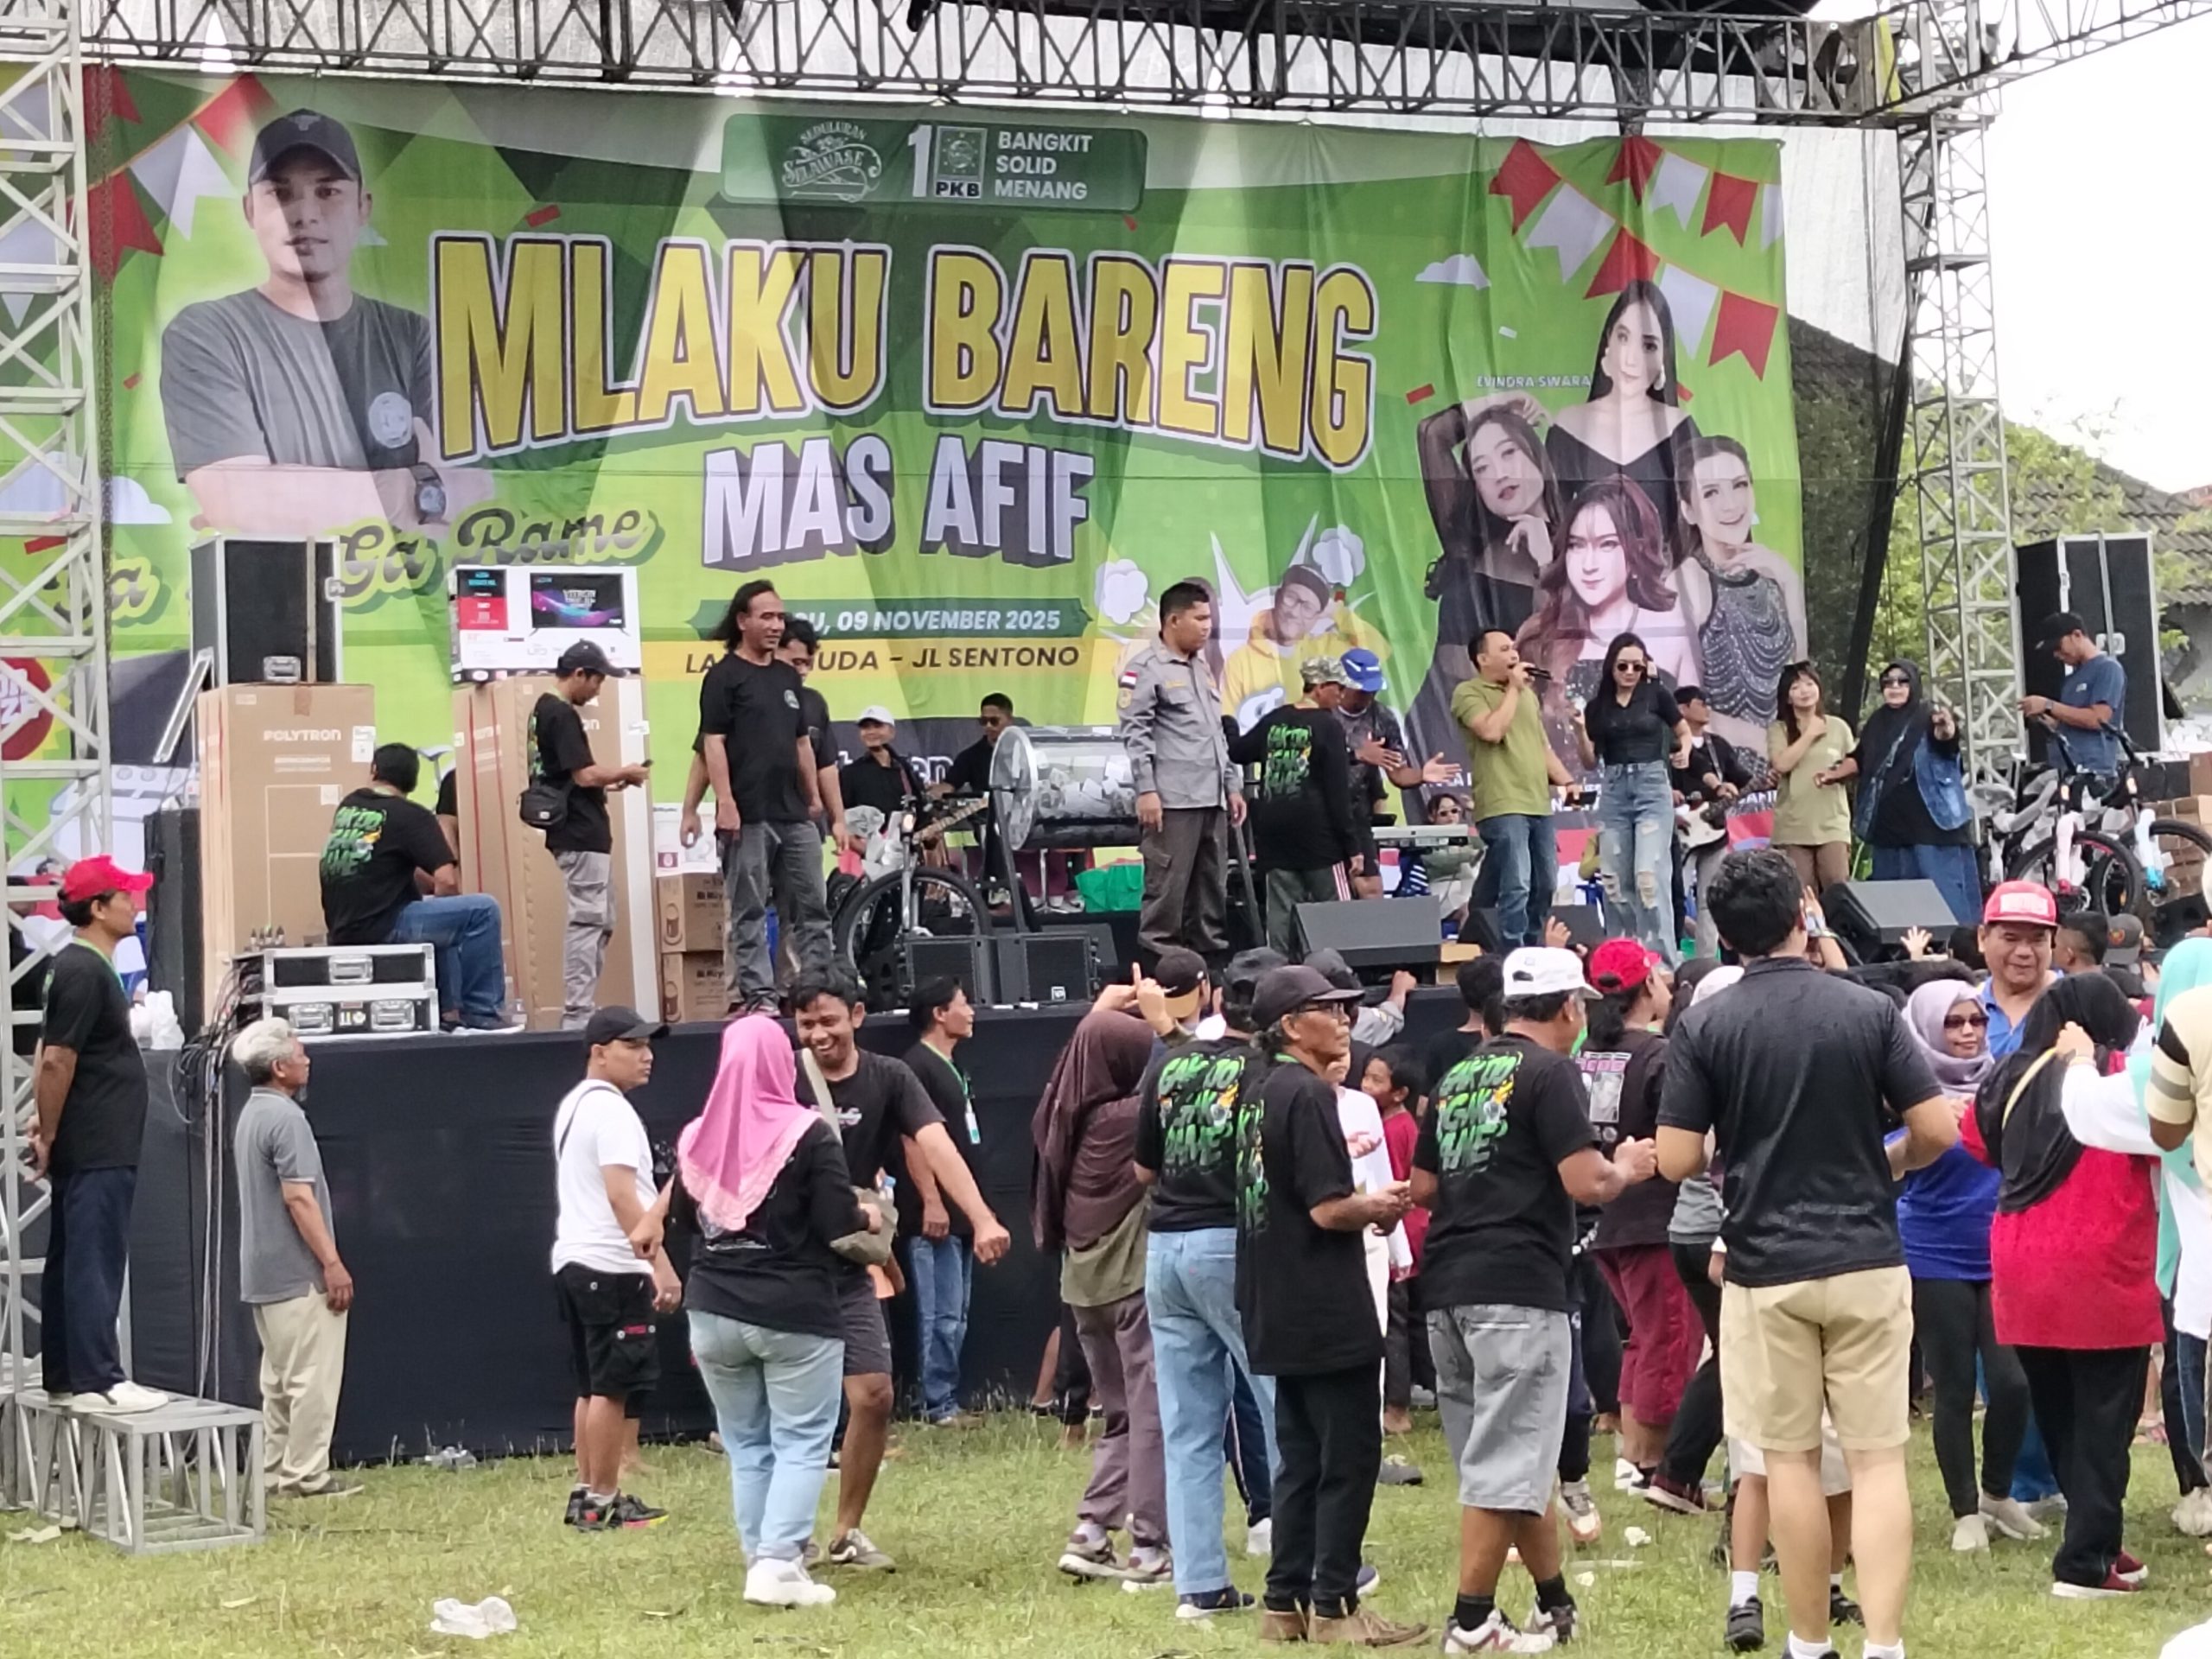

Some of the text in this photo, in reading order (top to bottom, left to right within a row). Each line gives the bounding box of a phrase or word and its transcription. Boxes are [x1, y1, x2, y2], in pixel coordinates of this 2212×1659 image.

[998, 131, 1092, 152] BANGKIT
[907, 124, 932, 198] 1
[996, 156, 1057, 175] SOLID
[936, 181, 981, 197] PKB
[995, 179, 1088, 200] MENANG
[432, 233, 1376, 472] MLAKU BARENG
[1538, 374, 1591, 388] SWARA
[702, 433, 1096, 567] MAS AFIF
[453, 507, 648, 566] Rame
[836, 610, 868, 632] 09
[873, 610, 1001, 632] NOVEMBER
[1005, 610, 1061, 631] 2025
[912, 648, 942, 668] JL
[949, 646, 1079, 667] SENTONO
[263, 728, 342, 741] POLYTRON
